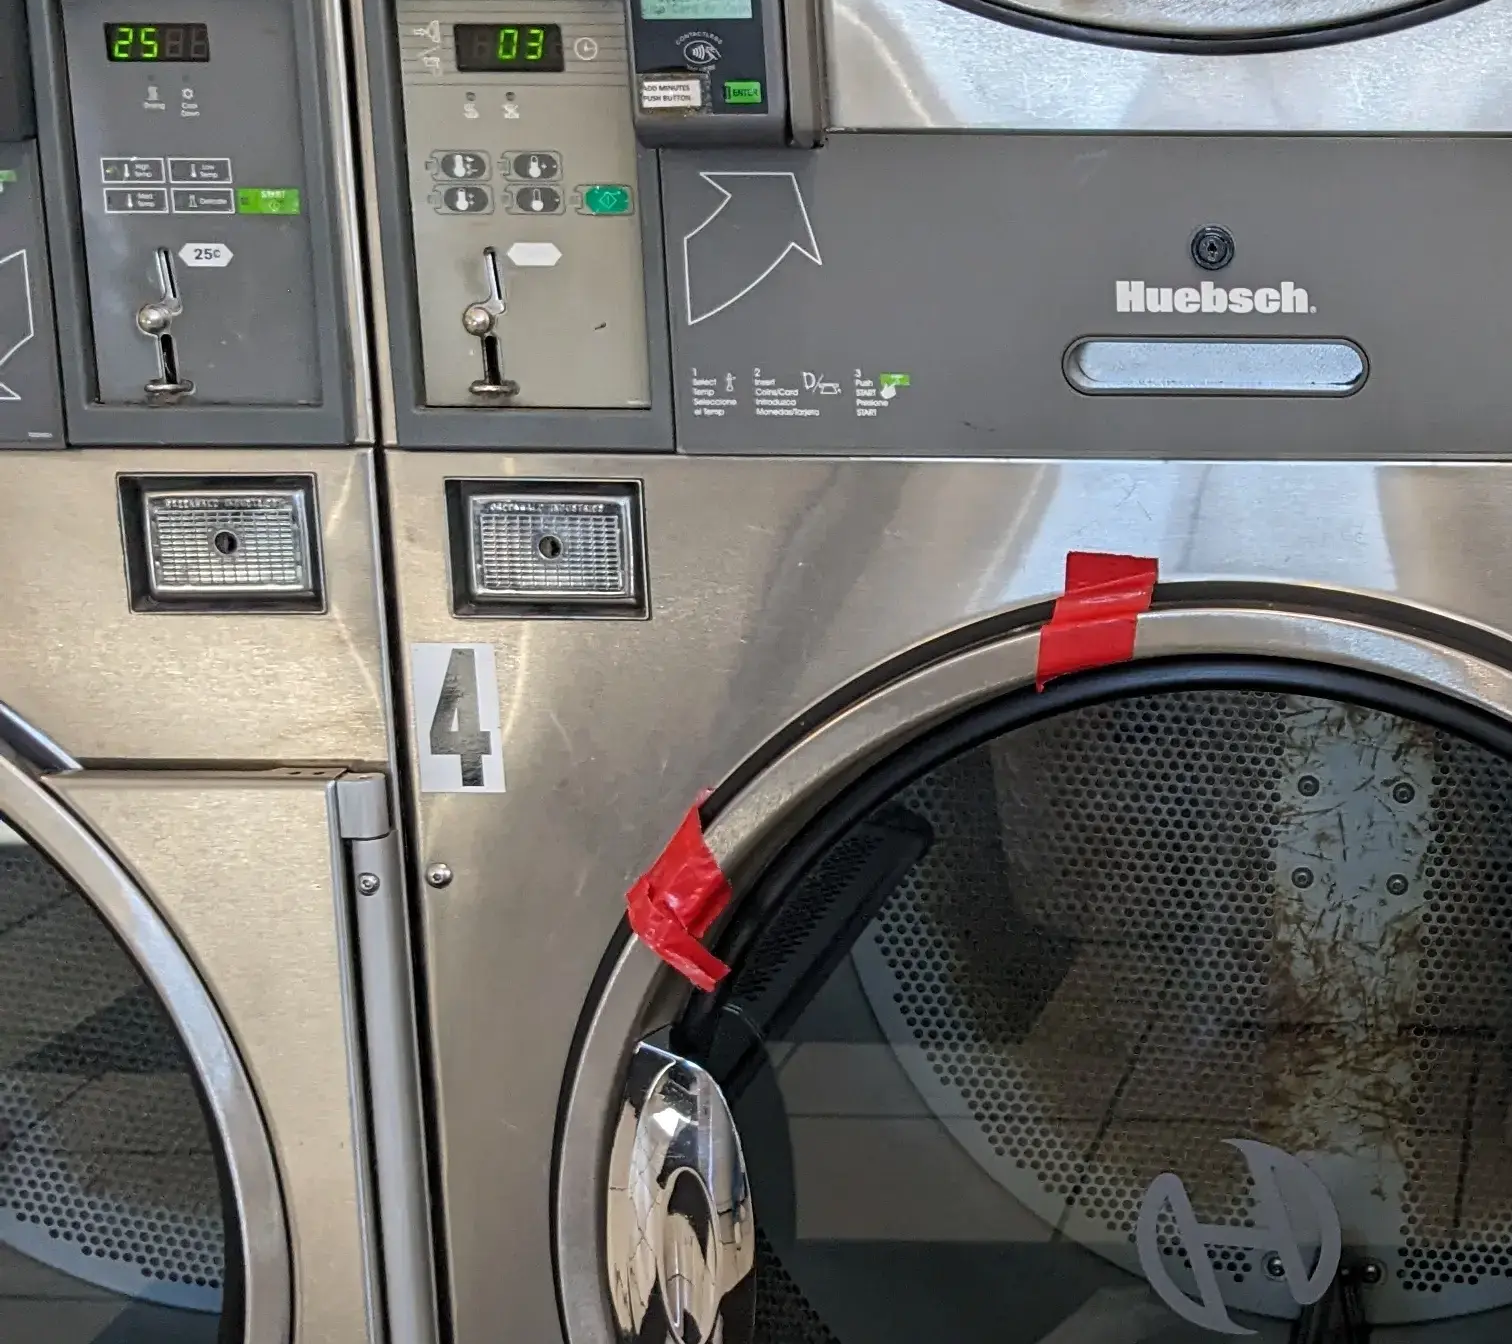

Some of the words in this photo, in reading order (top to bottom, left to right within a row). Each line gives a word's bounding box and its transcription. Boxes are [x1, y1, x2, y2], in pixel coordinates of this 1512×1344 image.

[113, 27, 158, 58] 25
[499, 28, 544, 60] 03
[732, 88, 759, 97] ENTER
[1116, 281, 1309, 313] Huebsch
[430, 648, 491, 788] 4
